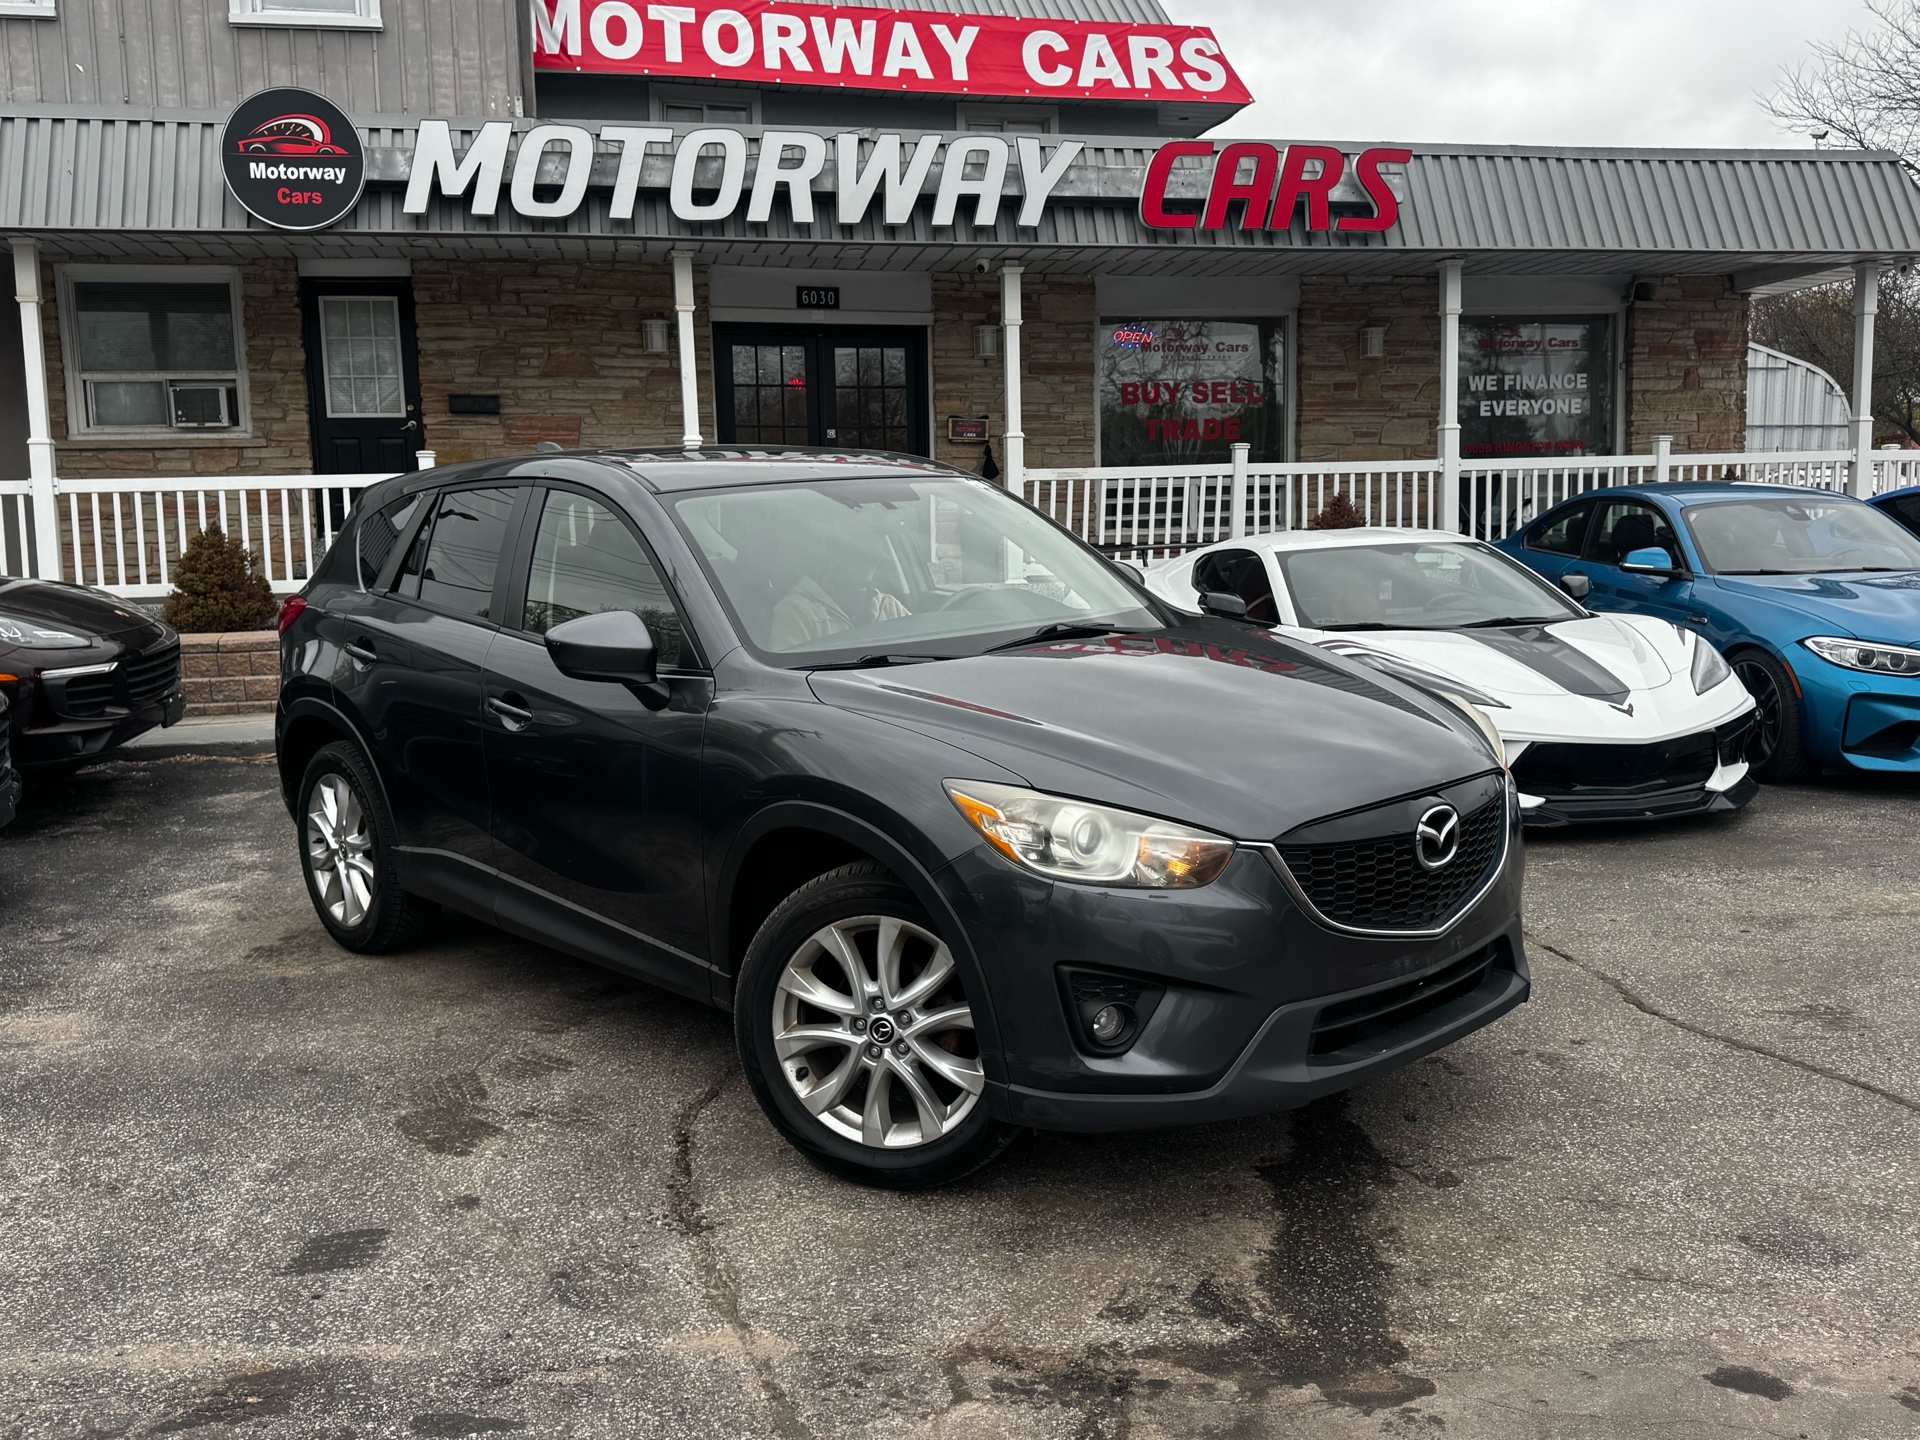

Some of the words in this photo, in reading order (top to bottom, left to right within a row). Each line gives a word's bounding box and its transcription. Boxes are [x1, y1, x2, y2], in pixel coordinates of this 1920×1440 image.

[531, 0, 980, 81] MOTORWAY
[1022, 29, 1228, 92] CARS
[249, 162, 346, 184] Motorway
[403, 119, 1085, 228] MOTORWAY
[1139, 141, 1413, 232] CARS
[277, 188, 323, 204] Cars
[802, 290, 836, 306] 6030
[1113, 330, 1154, 343] OPEN
[1479, 338, 1542, 351] Motorway
[1548, 337, 1579, 348] Cars
[1141, 341, 1208, 355] Motorway
[1215, 341, 1249, 353] Cars
[1468, 375, 1498, 391] WE
[1504, 373, 1588, 390] FINANCE
[1121, 381, 1181, 405] BUY
[1192, 381, 1264, 404] SELL
[1480, 398, 1582, 417] EVERYONE
[1143, 418, 1240, 441] TRADE
